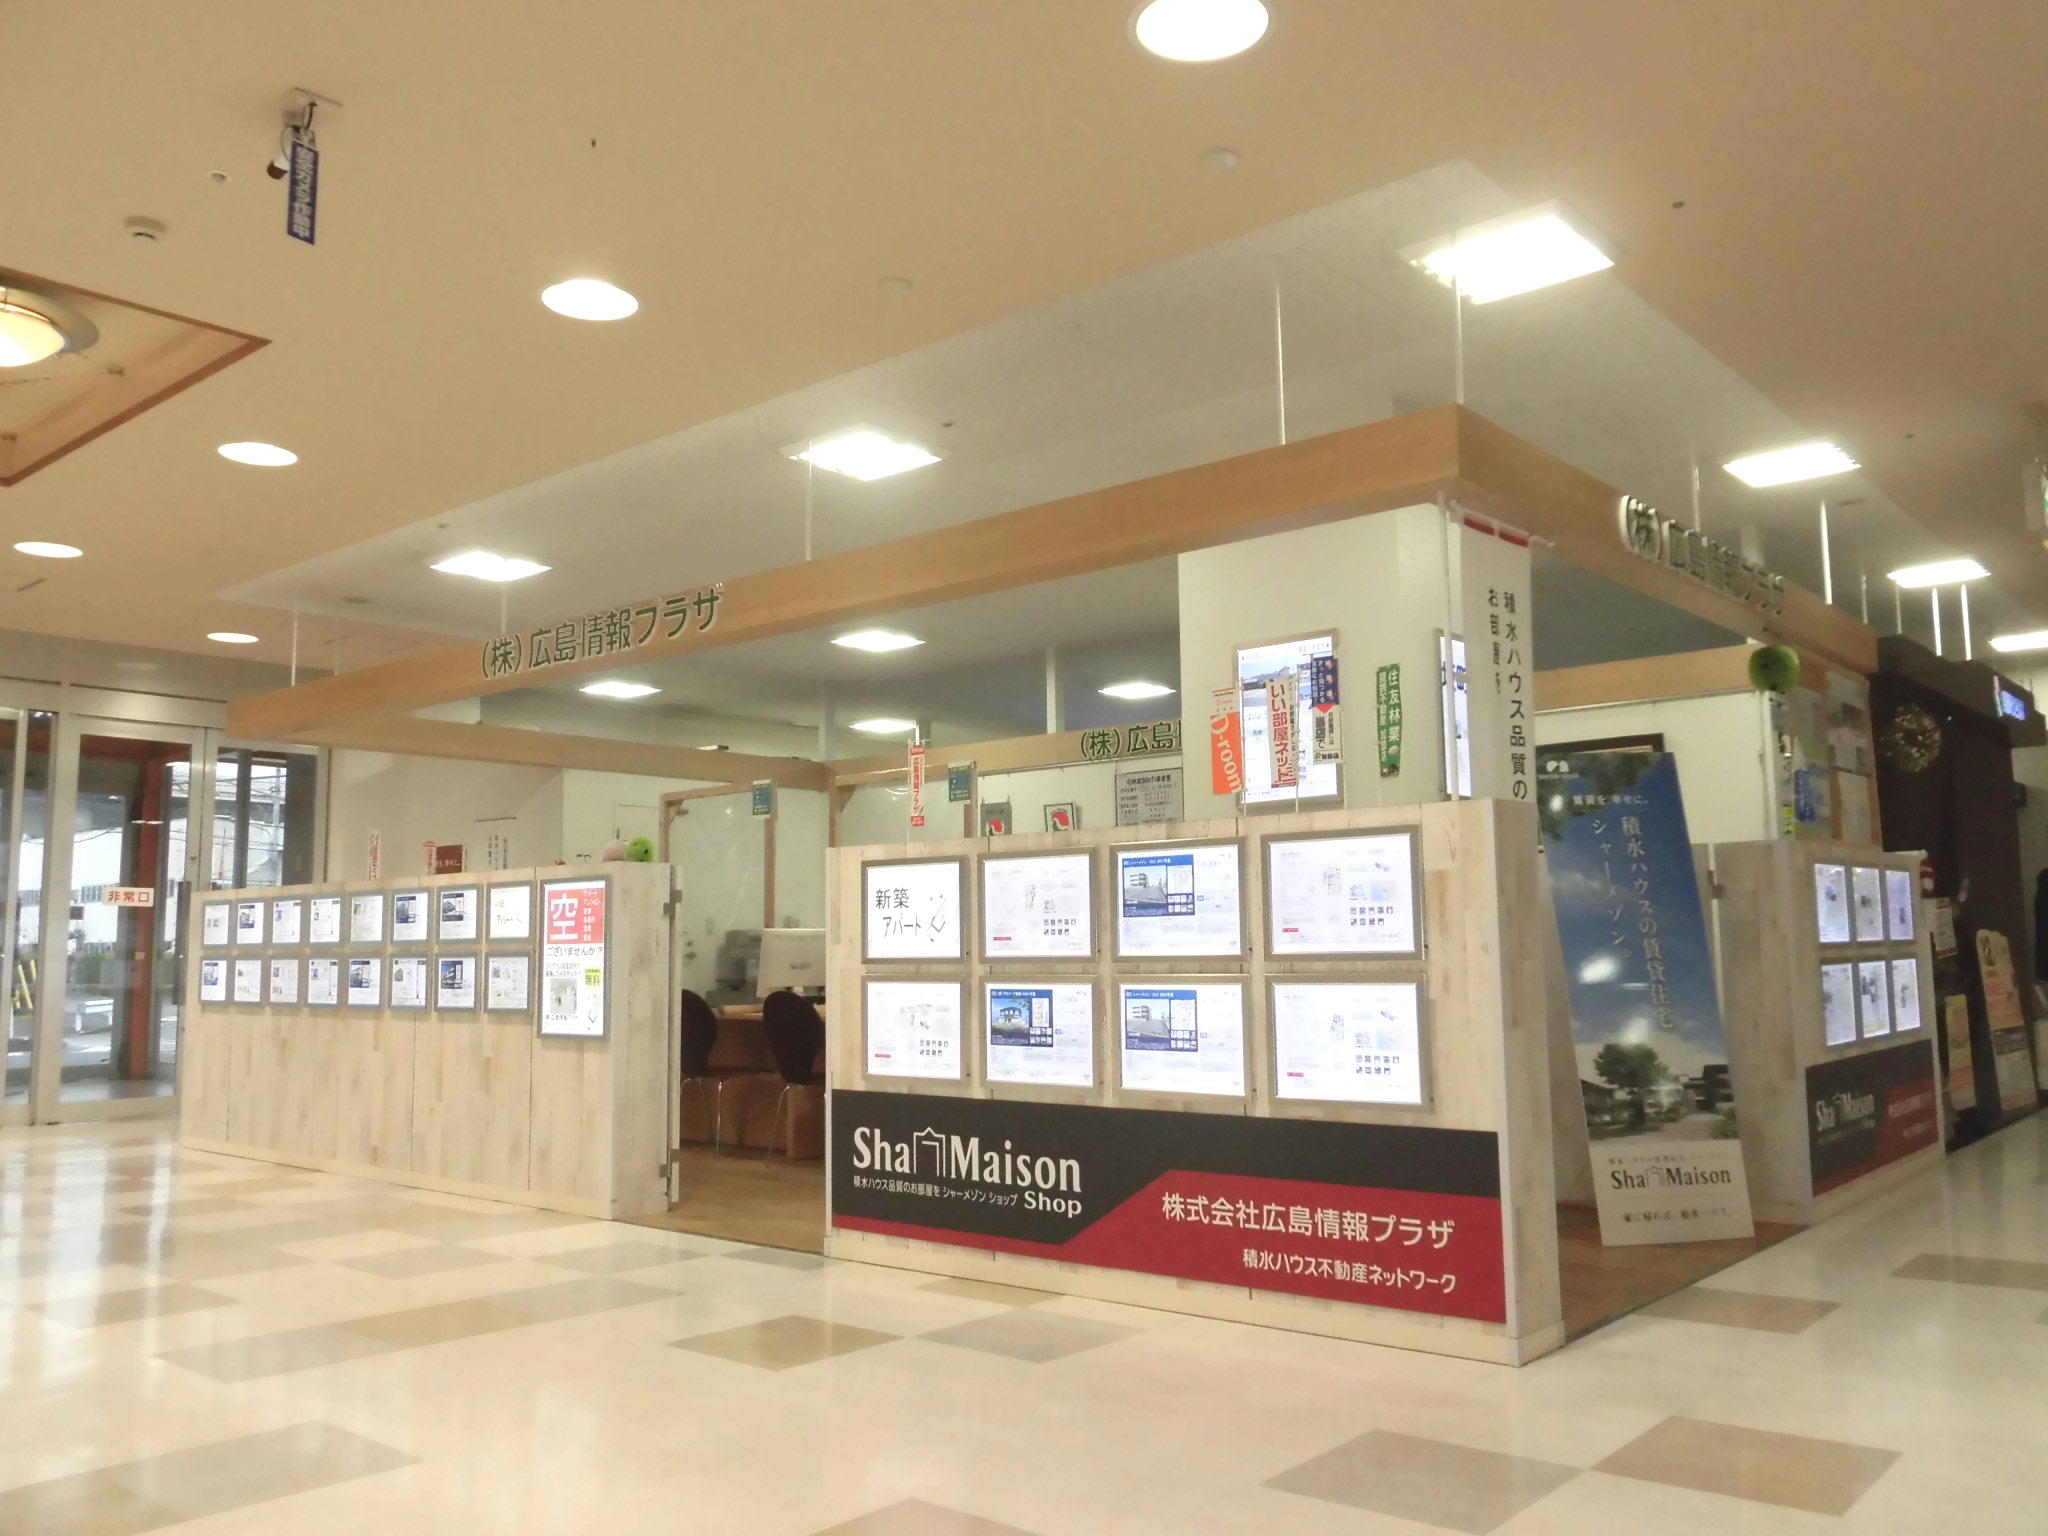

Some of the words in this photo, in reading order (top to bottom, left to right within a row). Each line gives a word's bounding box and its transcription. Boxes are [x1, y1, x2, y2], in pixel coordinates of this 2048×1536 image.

[482, 582, 724, 679] (株)広島情報プラザ
[1388, 669, 1401, 743] 住友林業
[1503, 591, 1528, 800] 積水ハウス品質の
[1210, 713, 1243, 793] D-room
[1270, 684, 1290, 783] いい部屋ネット
[107, 891, 150, 902] 非常口
[550, 892, 579, 940] 空
[875, 887, 910, 910] 新築
[883, 914, 922, 938] アパート
[853, 1126, 911, 1174] Sha
[950, 1134, 1082, 1193] Maison
[1611, 1170, 1646, 1190] Sha
[1665, 1166, 1732, 1187] Maison
[989, 1192, 1019, 1207] ショップ
[1024, 1190, 1082, 1218] Shop
[1162, 1191, 1456, 1250] 株式会社広島情報プラザ
[1243, 1248, 1457, 1294] 積水ハウス不動産ネットワーク
